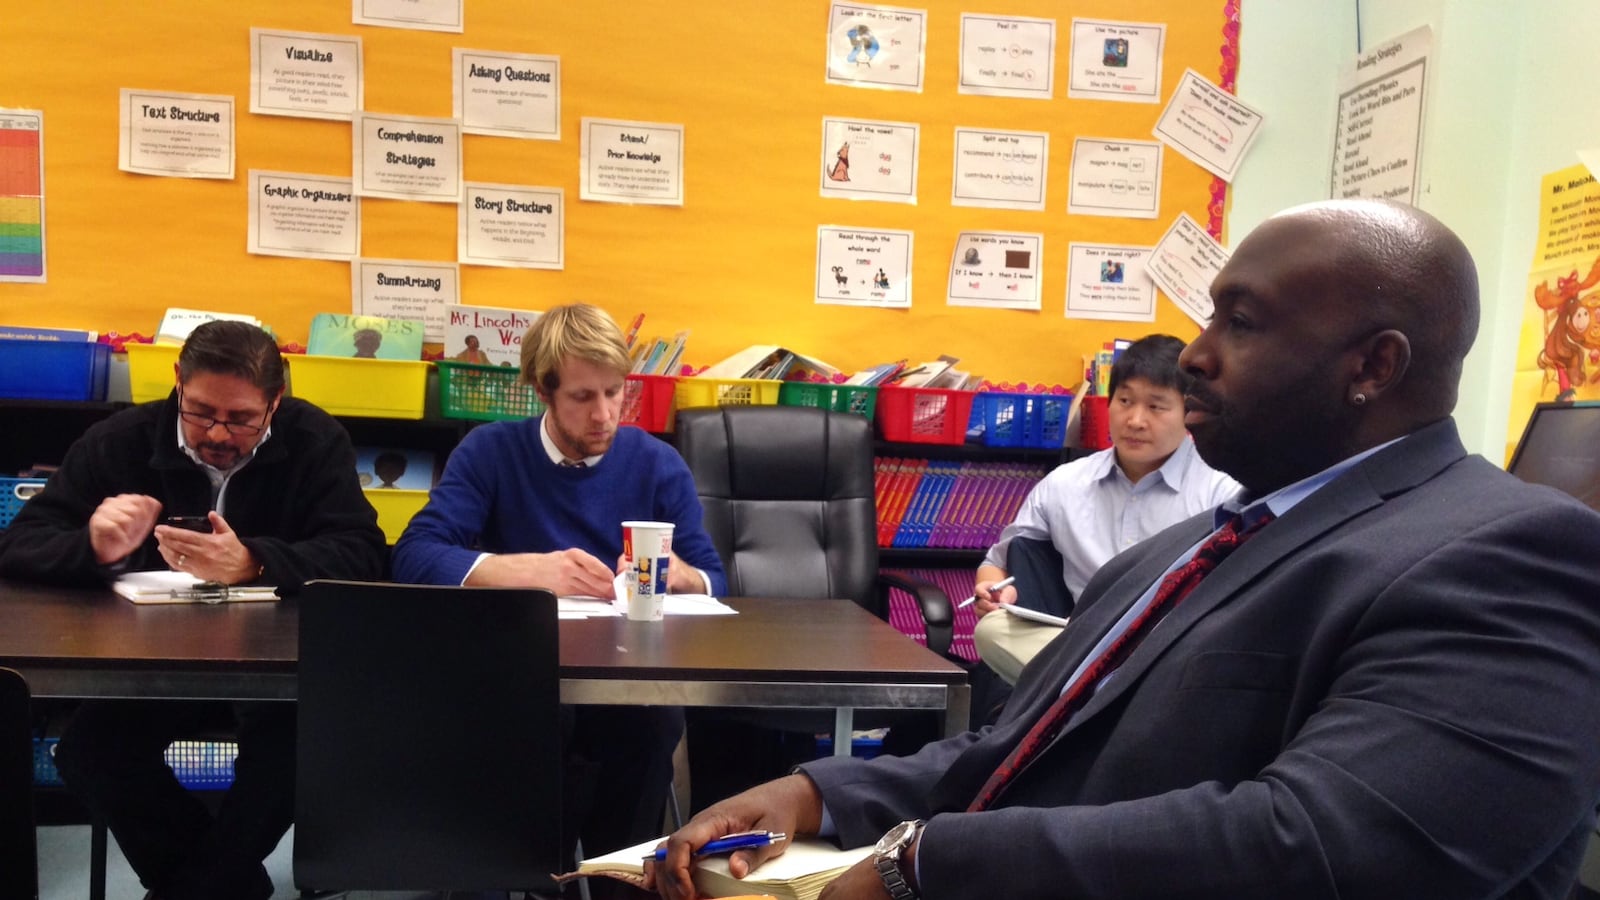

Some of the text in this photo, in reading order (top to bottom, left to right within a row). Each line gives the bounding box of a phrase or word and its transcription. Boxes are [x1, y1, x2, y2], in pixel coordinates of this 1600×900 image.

[285, 45, 334, 63] Visualize
[468, 63, 552, 84] Asking Questions
[141, 104, 221, 124] Text Structure
[376, 127, 445, 145] Comprehension
[386, 151, 437, 169] Strategies
[607, 148, 662, 164] Prior Knowledge
[264, 183, 352, 203] Graphic Organizers
[1552, 185, 1566, 194] Mr.
[474, 196, 554, 215] Story Structure
[838, 232, 854, 240] Read
[856, 234, 878, 242] through
[376, 272, 442, 292] Summarizing
[450, 310, 472, 326] Mr.
[473, 310, 530, 330] Lincoln's
[499, 328, 522, 346] Wa
